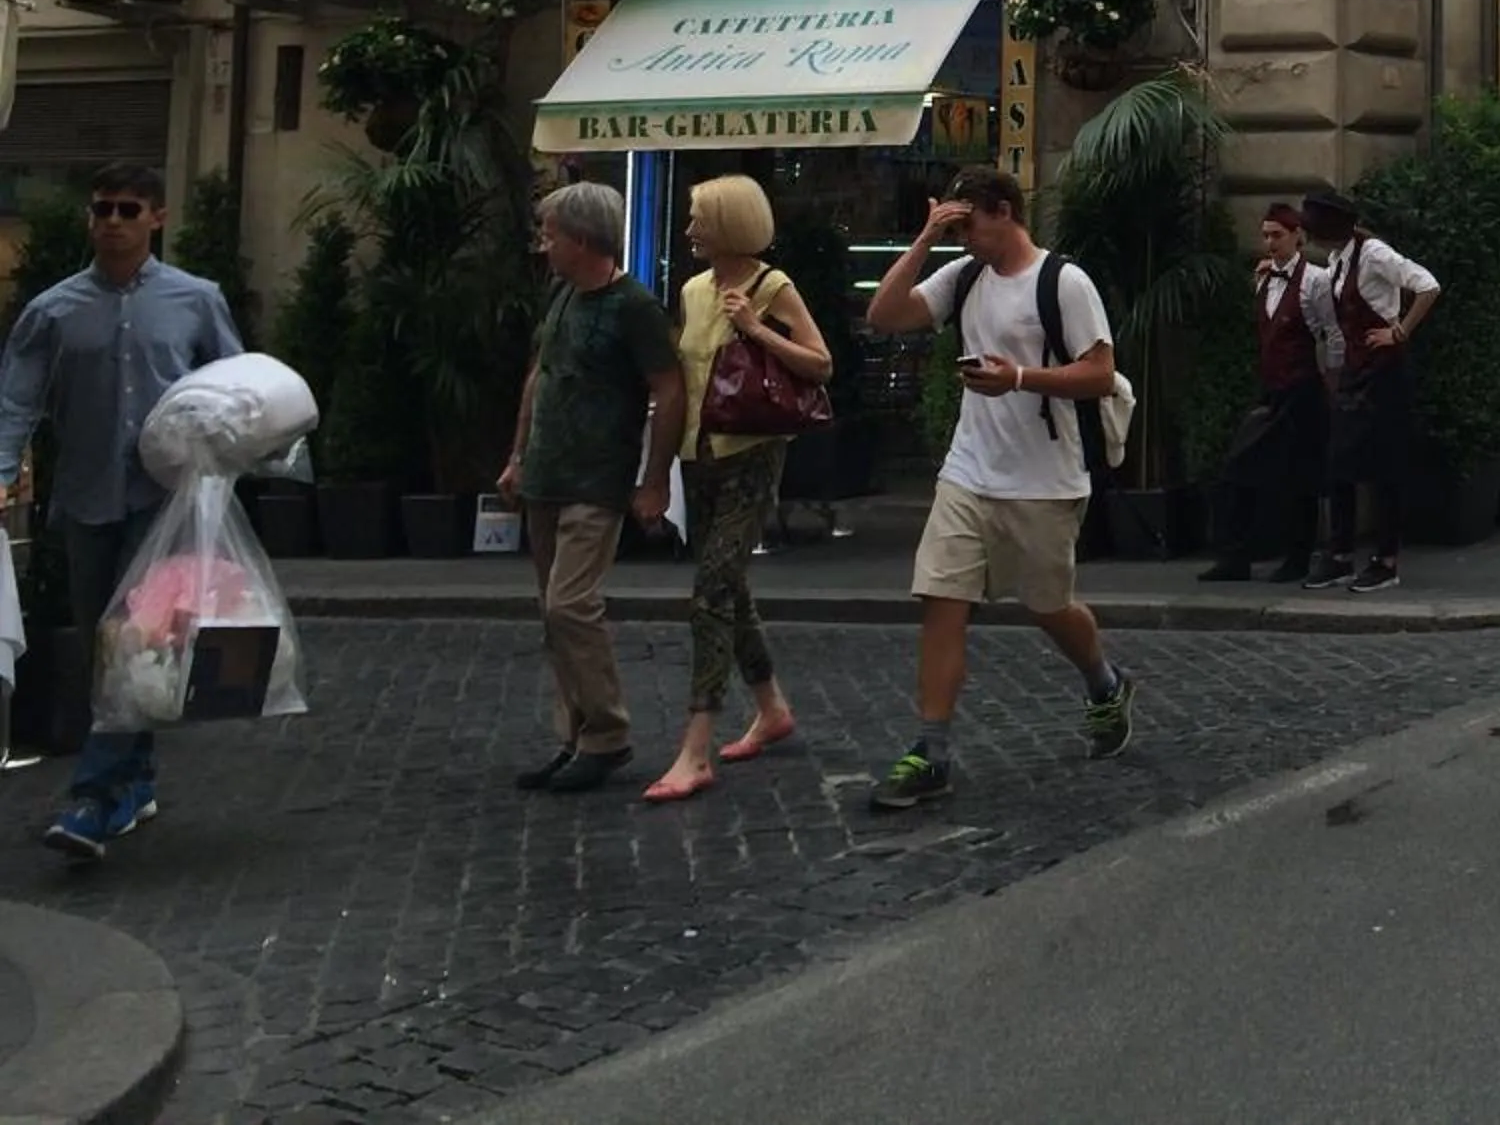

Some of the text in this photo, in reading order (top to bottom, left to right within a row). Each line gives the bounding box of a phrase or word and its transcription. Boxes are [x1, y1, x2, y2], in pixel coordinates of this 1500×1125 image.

[673, 8, 894, 35] CAFFETTERIA
[607, 38, 911, 75] Antica Roma
[578, 107, 878, 141] BAR-GELATERIA
